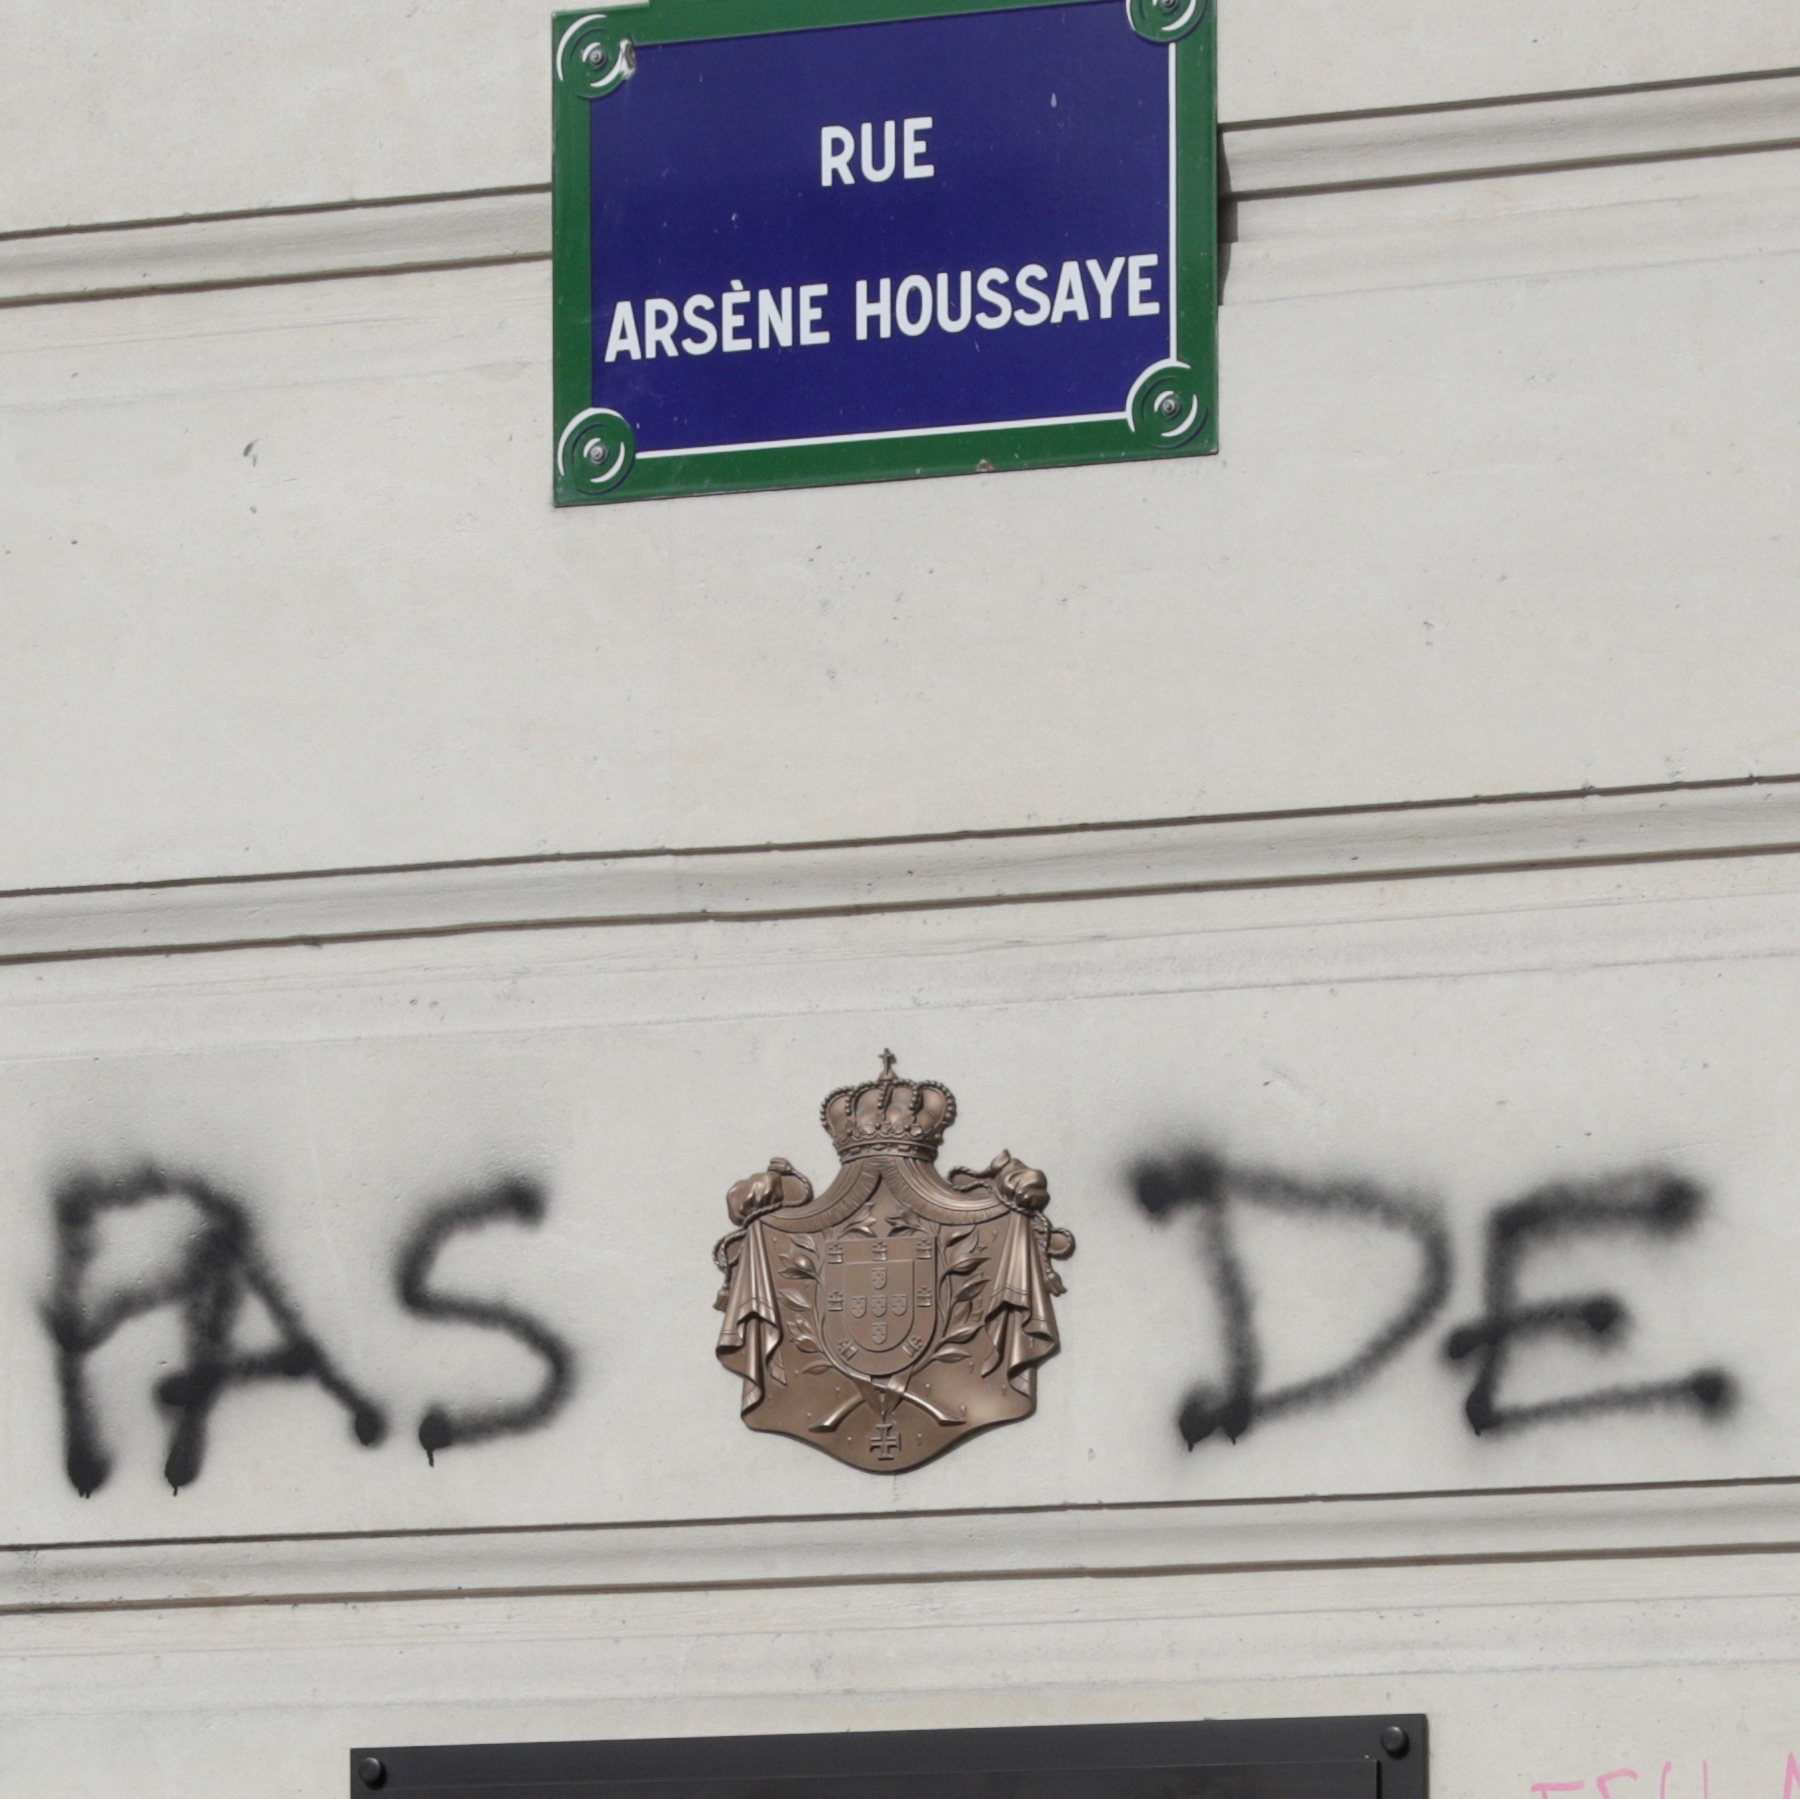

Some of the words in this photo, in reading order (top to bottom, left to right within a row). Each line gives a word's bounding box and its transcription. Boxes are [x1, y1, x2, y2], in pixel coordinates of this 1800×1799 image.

[820, 116, 935, 187] RUE
[604, 279, 830, 363] ARSÈNE
[855, 253, 1161, 342] HOUSSAYE
[35, 1157, 580, 1499] PAS
[1121, 1142, 1736, 1448] DE
